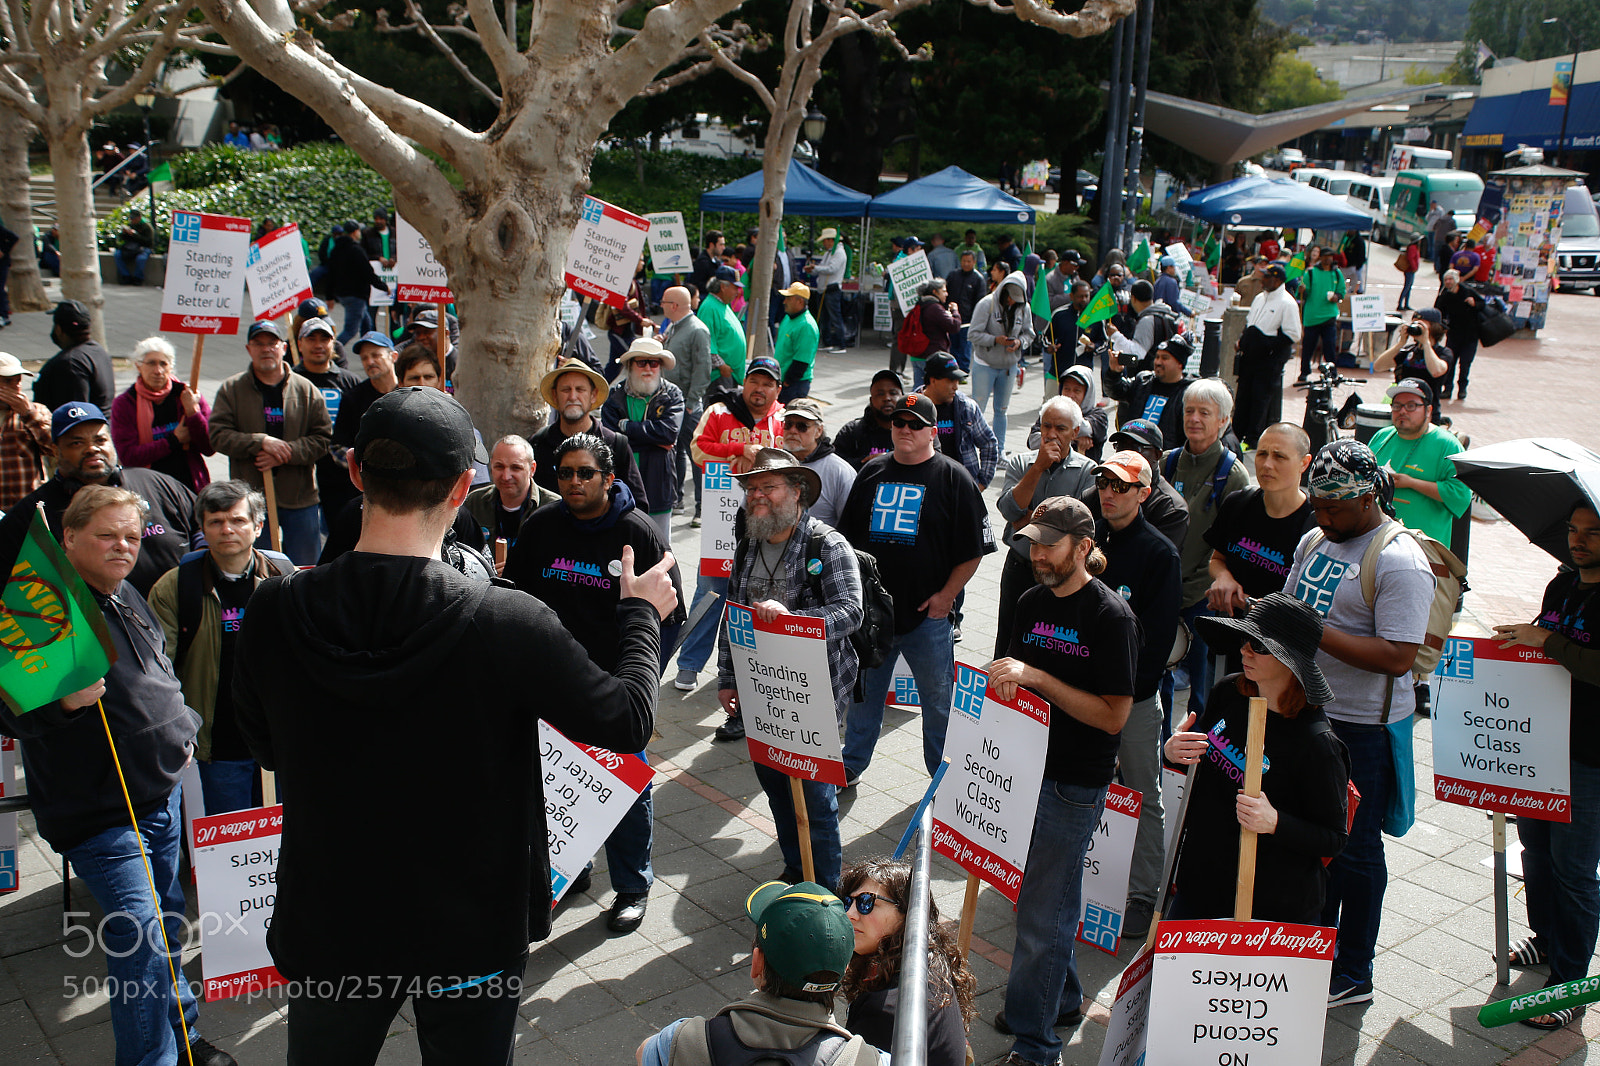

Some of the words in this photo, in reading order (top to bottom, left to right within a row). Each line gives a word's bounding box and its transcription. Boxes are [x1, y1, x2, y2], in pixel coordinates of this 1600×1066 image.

[583, 198, 604, 212] UP
[175, 213, 200, 228] UP
[582, 209, 602, 224] TE
[176, 228, 198, 242] TE
[586, 228, 627, 253] Standing
[659, 230, 672, 238] FOR
[186, 250, 233, 267] Standing
[584, 238, 624, 262] Together
[654, 243, 684, 252] EQUALITY
[256, 252, 290, 274] Standing
[588, 254, 604, 266] for
[185, 265, 232, 280] Together
[259, 262, 292, 284] Together
[416, 266, 446, 278] Work
[574, 260, 604, 280] Better
[605, 274, 620, 286] UC
[898, 272, 928, 292] EQUALITY
[194, 282, 210, 292] for
[213, 285, 220, 293] a
[260, 288, 286, 306] Better
[288, 278, 300, 290] UC
[268, 280, 280, 290] for
[399, 286, 428, 300] Fighting
[428, 288, 440, 300] for
[573, 278, 610, 302] Solidarity
[177, 294, 213, 308] Better
[217, 298, 230, 308] UC
[181, 316, 222, 334] Solidarity
[706, 476, 731, 489] TE
[876, 486, 921, 508] UP
[875, 508, 916, 532] TE
[542, 568, 611, 589] UPTESTRONG
[1304, 554, 1344, 587] UP
[1300, 580, 1332, 616] TE
[728, 606, 752, 628] UP
[730, 626, 755, 648] TE
[784, 623, 822, 638] upte.org
[1022, 632, 1090, 657] UPTESTRONG
[748, 657, 808, 688] Standing
[1441, 658, 1472, 678] TE
[750, 677, 811, 704] Together
[896, 679, 918, 690] TE
[958, 668, 986, 692] UP
[896, 692, 920, 704] UP
[958, 688, 982, 716] TE
[1484, 692, 1510, 710] No
[766, 702, 786, 720] for
[791, 711, 800, 722] a
[1017, 698, 1048, 722] upte.org
[755, 716, 796, 742] Better
[800, 729, 822, 746] UC
[1464, 710, 1532, 734] Second
[540, 741, 562, 766] UC
[982, 736, 1000, 760] No
[1474, 733, 1521, 754] Class
[768, 746, 819, 780] Solidarity
[964, 754, 1013, 792] Second
[1460, 752, 1536, 778] Workers
[544, 772, 556, 785] a
[562, 761, 613, 804] Better
[554, 783, 580, 808] for
[967, 782, 1000, 814] Class
[1106, 792, 1140, 812] Fightin
[1436, 779, 1478, 804] Fighting
[1478, 788, 1497, 804] for
[1499, 794, 1508, 804] a
[1510, 792, 1544, 810] better
[1546, 798, 1566, 812] UC
[220, 818, 256, 836] better
[258, 818, 268, 829] a
[955, 798, 1008, 844] Workers
[197, 826, 218, 844] UC
[932, 825, 962, 856] Fighting
[961, 844, 974, 862] for
[974, 855, 982, 866] a
[982, 857, 1006, 883] better
[1007, 871, 1020, 889] UC
[1086, 905, 1116, 932] TE
[1084, 927, 1116, 950] UP
[1159, 931, 1182, 948] UC
[1186, 931, 1228, 950] better
[1230, 934, 1242, 944] a
[1245, 927, 1270, 950] for
[1270, 926, 1332, 954] Fighting
[209, 972, 258, 991] upte.org
[1192, 970, 1289, 992] Workers
[1510, 985, 1569, 1014] AFSCME
[1571, 978, 1600, 996] 329
[1208, 998, 1268, 1019] Class
[1194, 1024, 1279, 1046] Second
[1218, 1052, 1249, 1066] No
